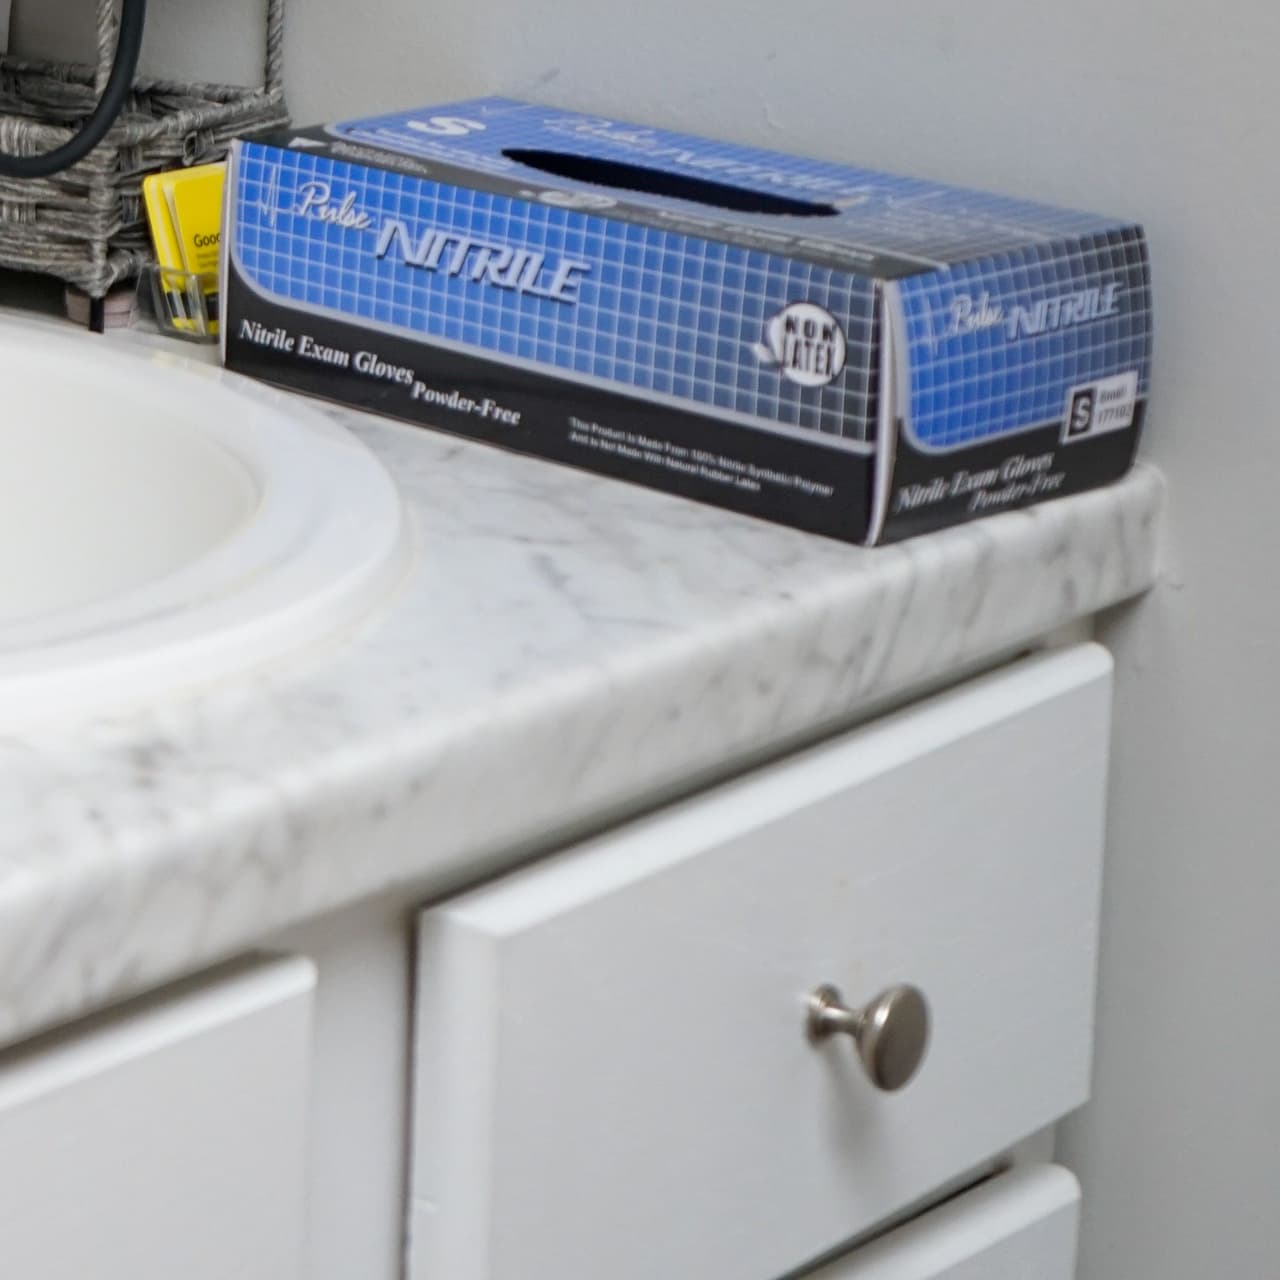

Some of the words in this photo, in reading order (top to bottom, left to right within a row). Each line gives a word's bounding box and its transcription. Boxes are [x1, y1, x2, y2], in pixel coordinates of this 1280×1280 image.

[294, 180, 372, 230] Pulse
[375, 217, 591, 305] NITRILE
[784, 314, 838, 342] NON
[1005, 282, 1124, 342] NITRILE
[240, 320, 295, 351] Nitrile
[298, 335, 351, 369] Exam
[355, 351, 415, 385] Gloves
[782, 337, 837, 376] LATEX
[411, 381, 522, 424] Powder-Free
[1071, 395, 1092, 429] S
[569, 416, 590, 431] This
[592, 422, 626, 441] Product
[638, 434, 664, 451] Made
[665, 441, 689, 458] From
[748, 463, 794, 486] Synthetic
[794, 474, 835, 498] Polymer
[569, 431, 590, 445] And
[600, 440, 617, 452] Not
[617, 444, 642, 460] Made
[643, 451, 665, 466] With
[666, 456, 700, 473] Natural
[700, 464, 735, 482] Rubber
[736, 474, 762, 493] Latex
[893, 476, 948, 516] Nitrile
[950, 469, 1000, 496] Exam
[1001, 452, 1056, 481] Gloves
[971, 472, 1067, 513] Powder-Free
